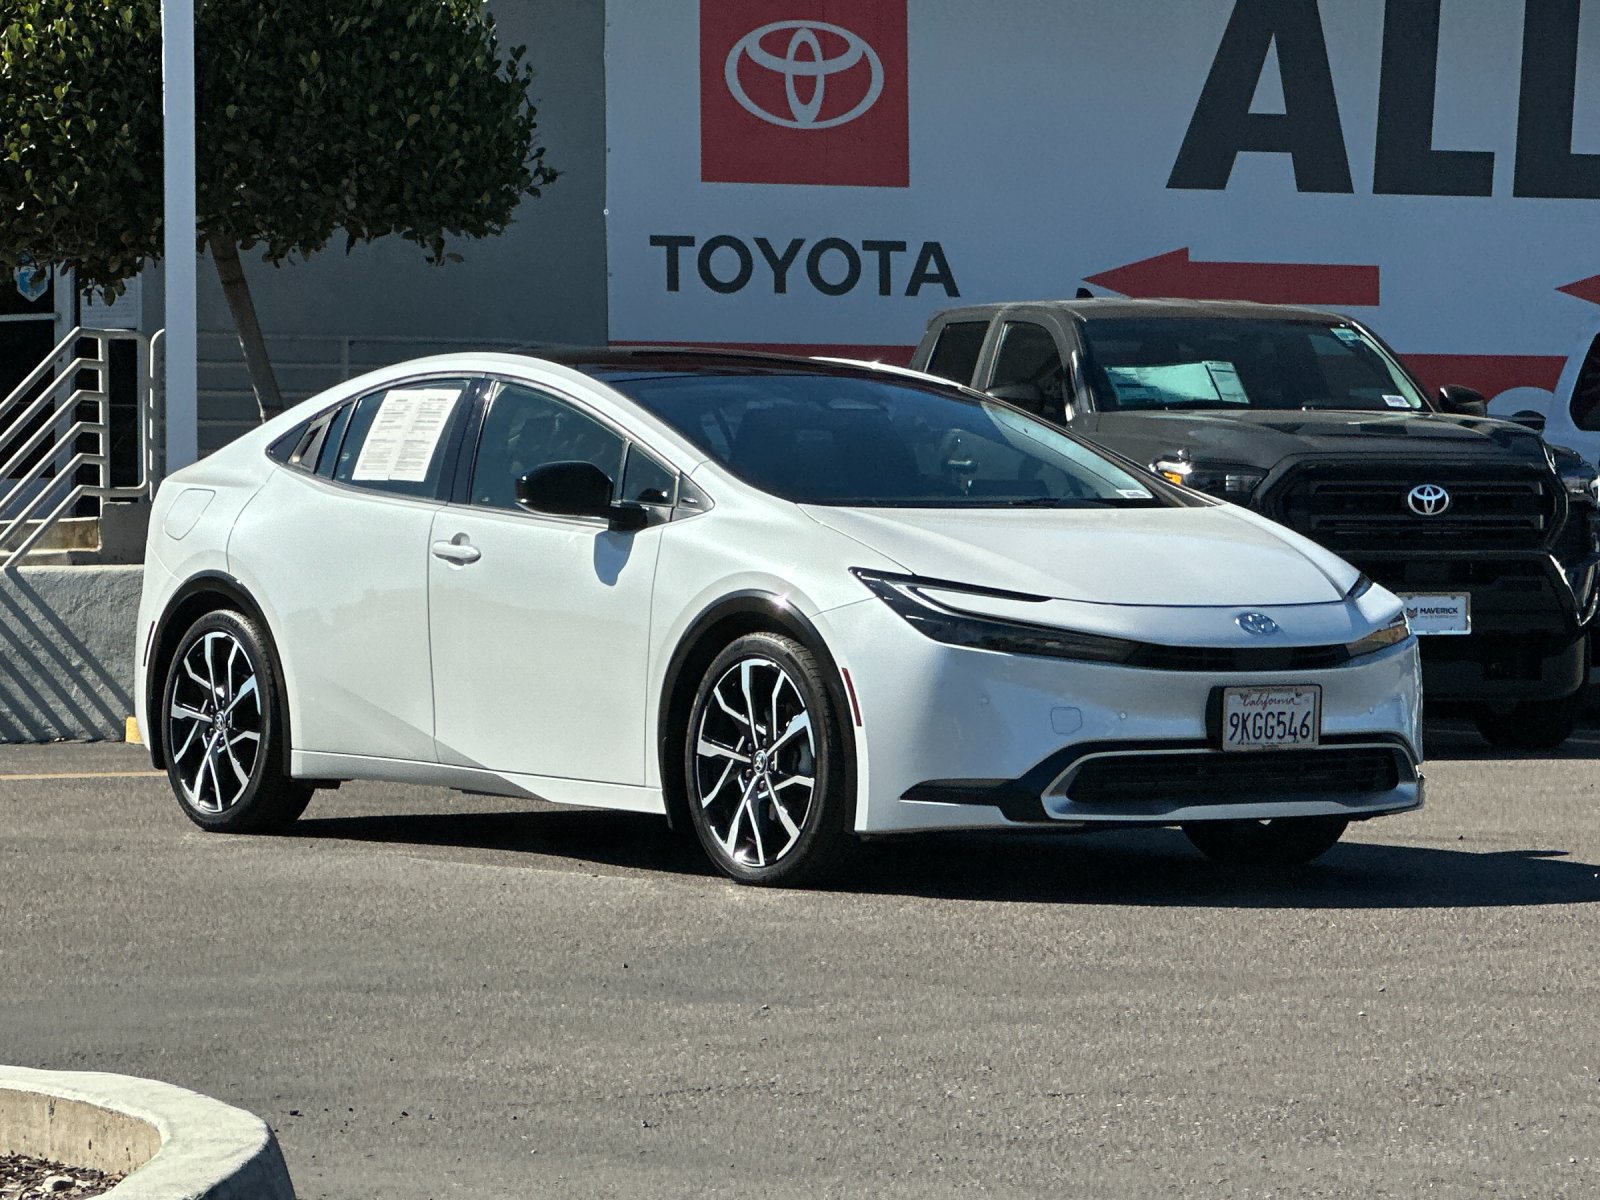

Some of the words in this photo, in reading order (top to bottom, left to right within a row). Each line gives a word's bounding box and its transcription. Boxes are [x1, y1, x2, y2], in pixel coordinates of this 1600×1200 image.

[1166, 0, 1600, 200] ALL
[650, 235, 960, 298] TOYOTA
[1420, 607, 1459, 615] MAVERICK
[1242, 693, 1300, 710] California
[1229, 711, 1311, 741] 9KGG546
